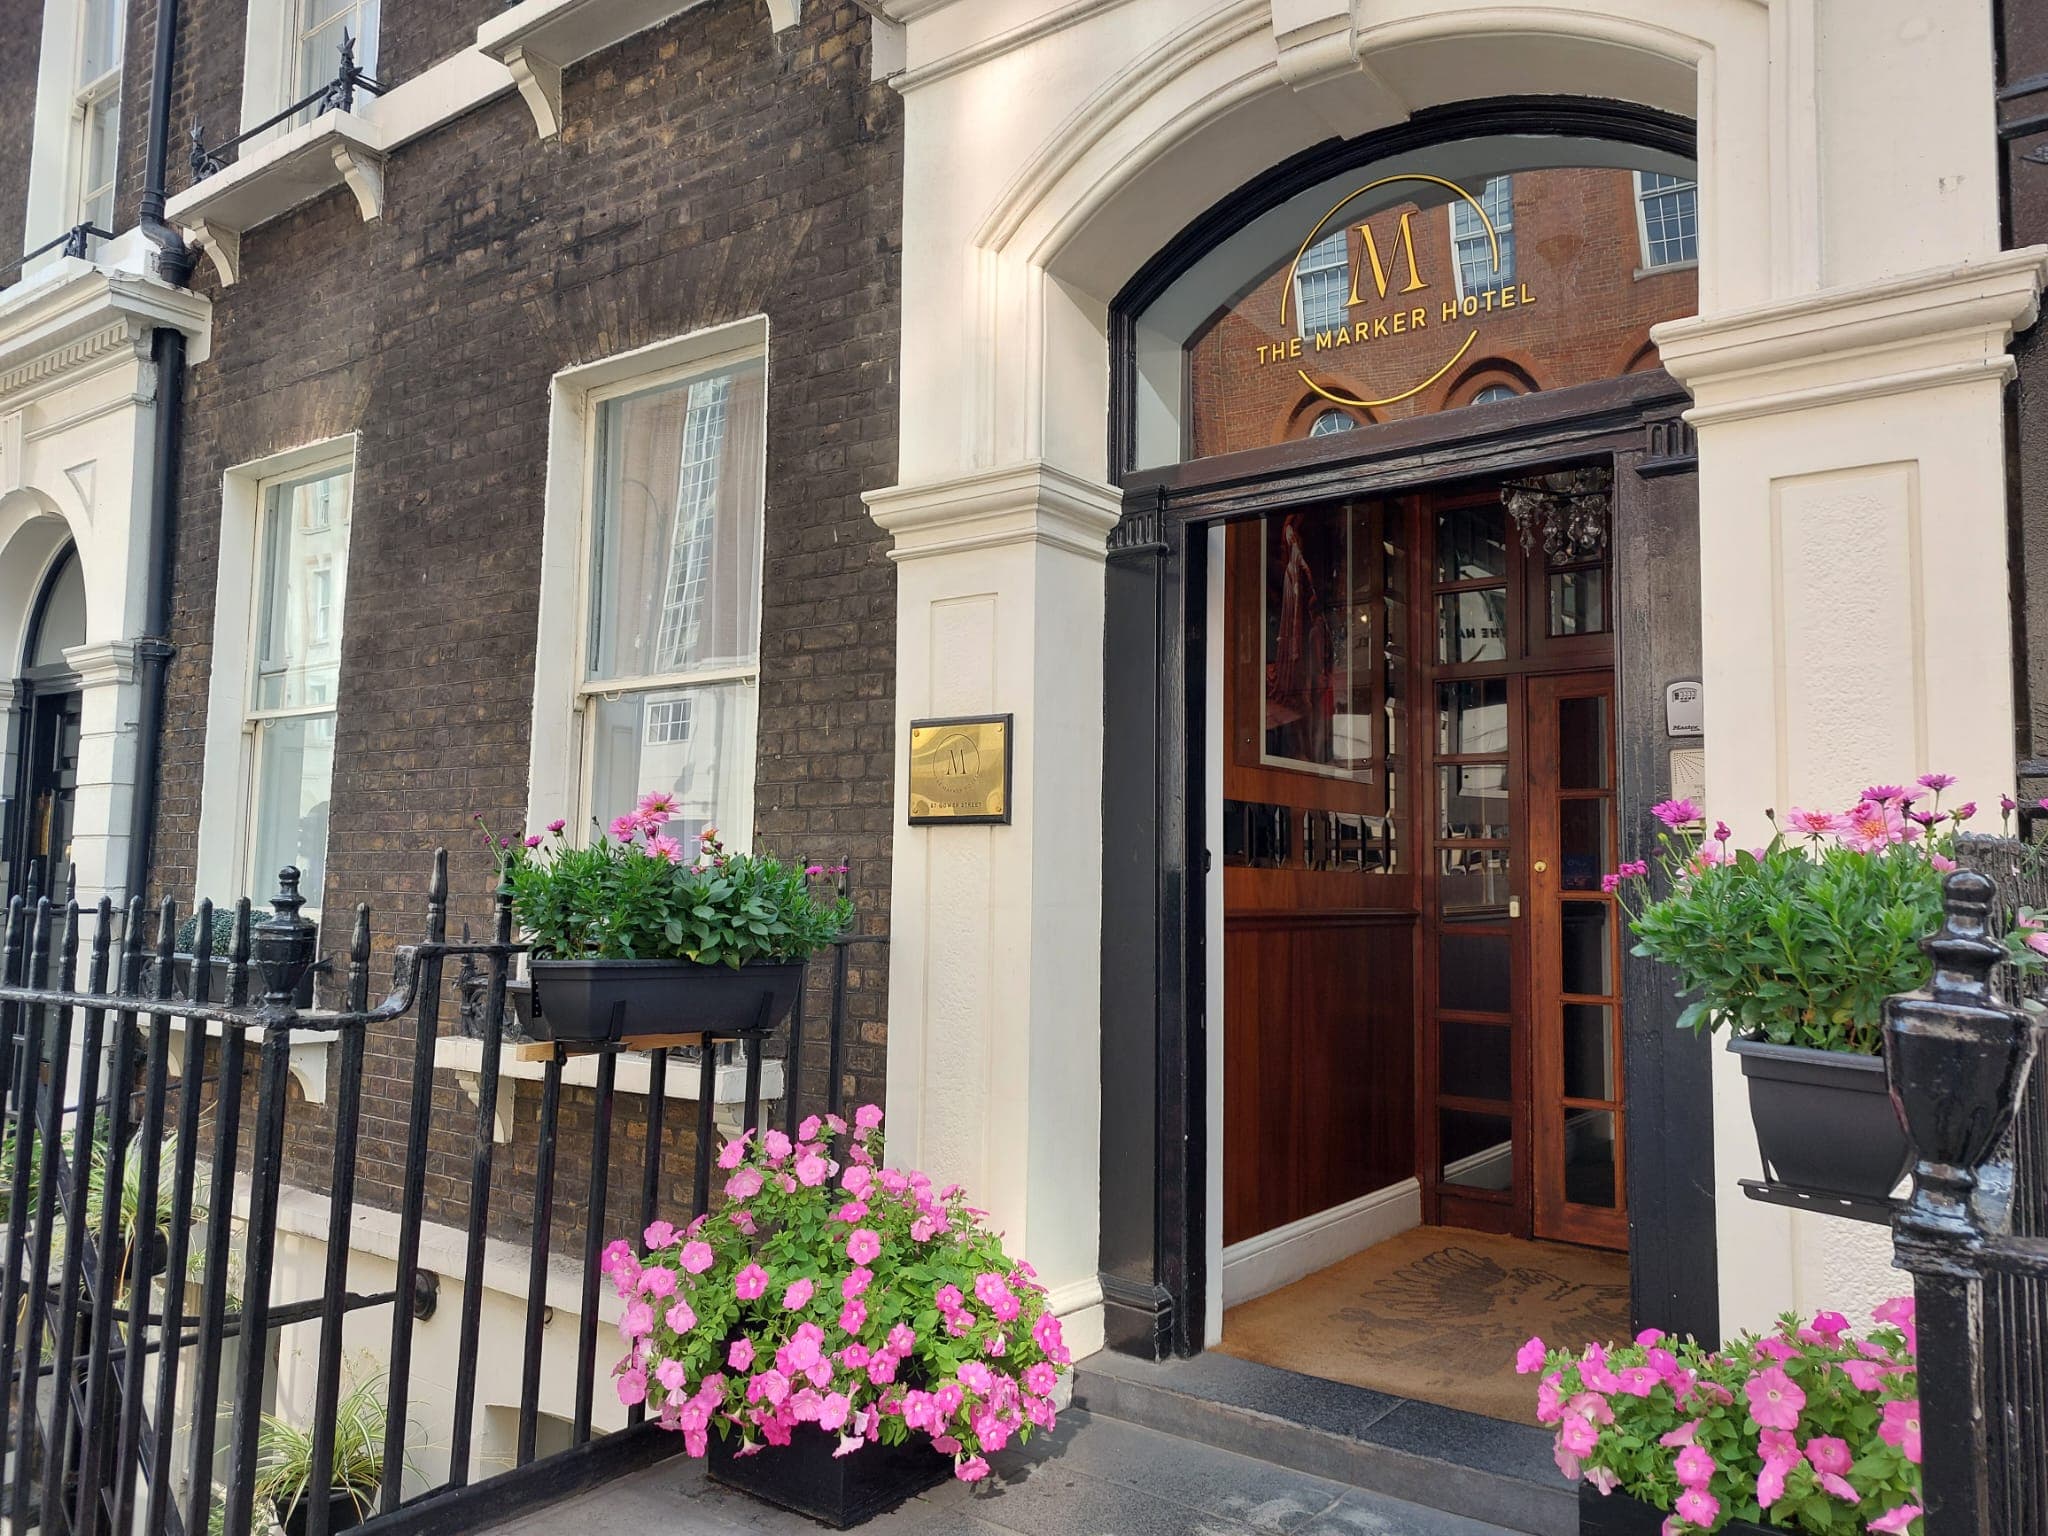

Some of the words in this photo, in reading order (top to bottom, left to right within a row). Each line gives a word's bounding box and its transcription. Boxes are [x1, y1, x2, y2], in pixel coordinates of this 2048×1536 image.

[1343, 209, 1431, 308] M
[1256, 337, 1303, 365] THE
[1315, 307, 1427, 351] MARKER
[1441, 283, 1537, 322] HOTEL
[945, 749, 968, 775] M
